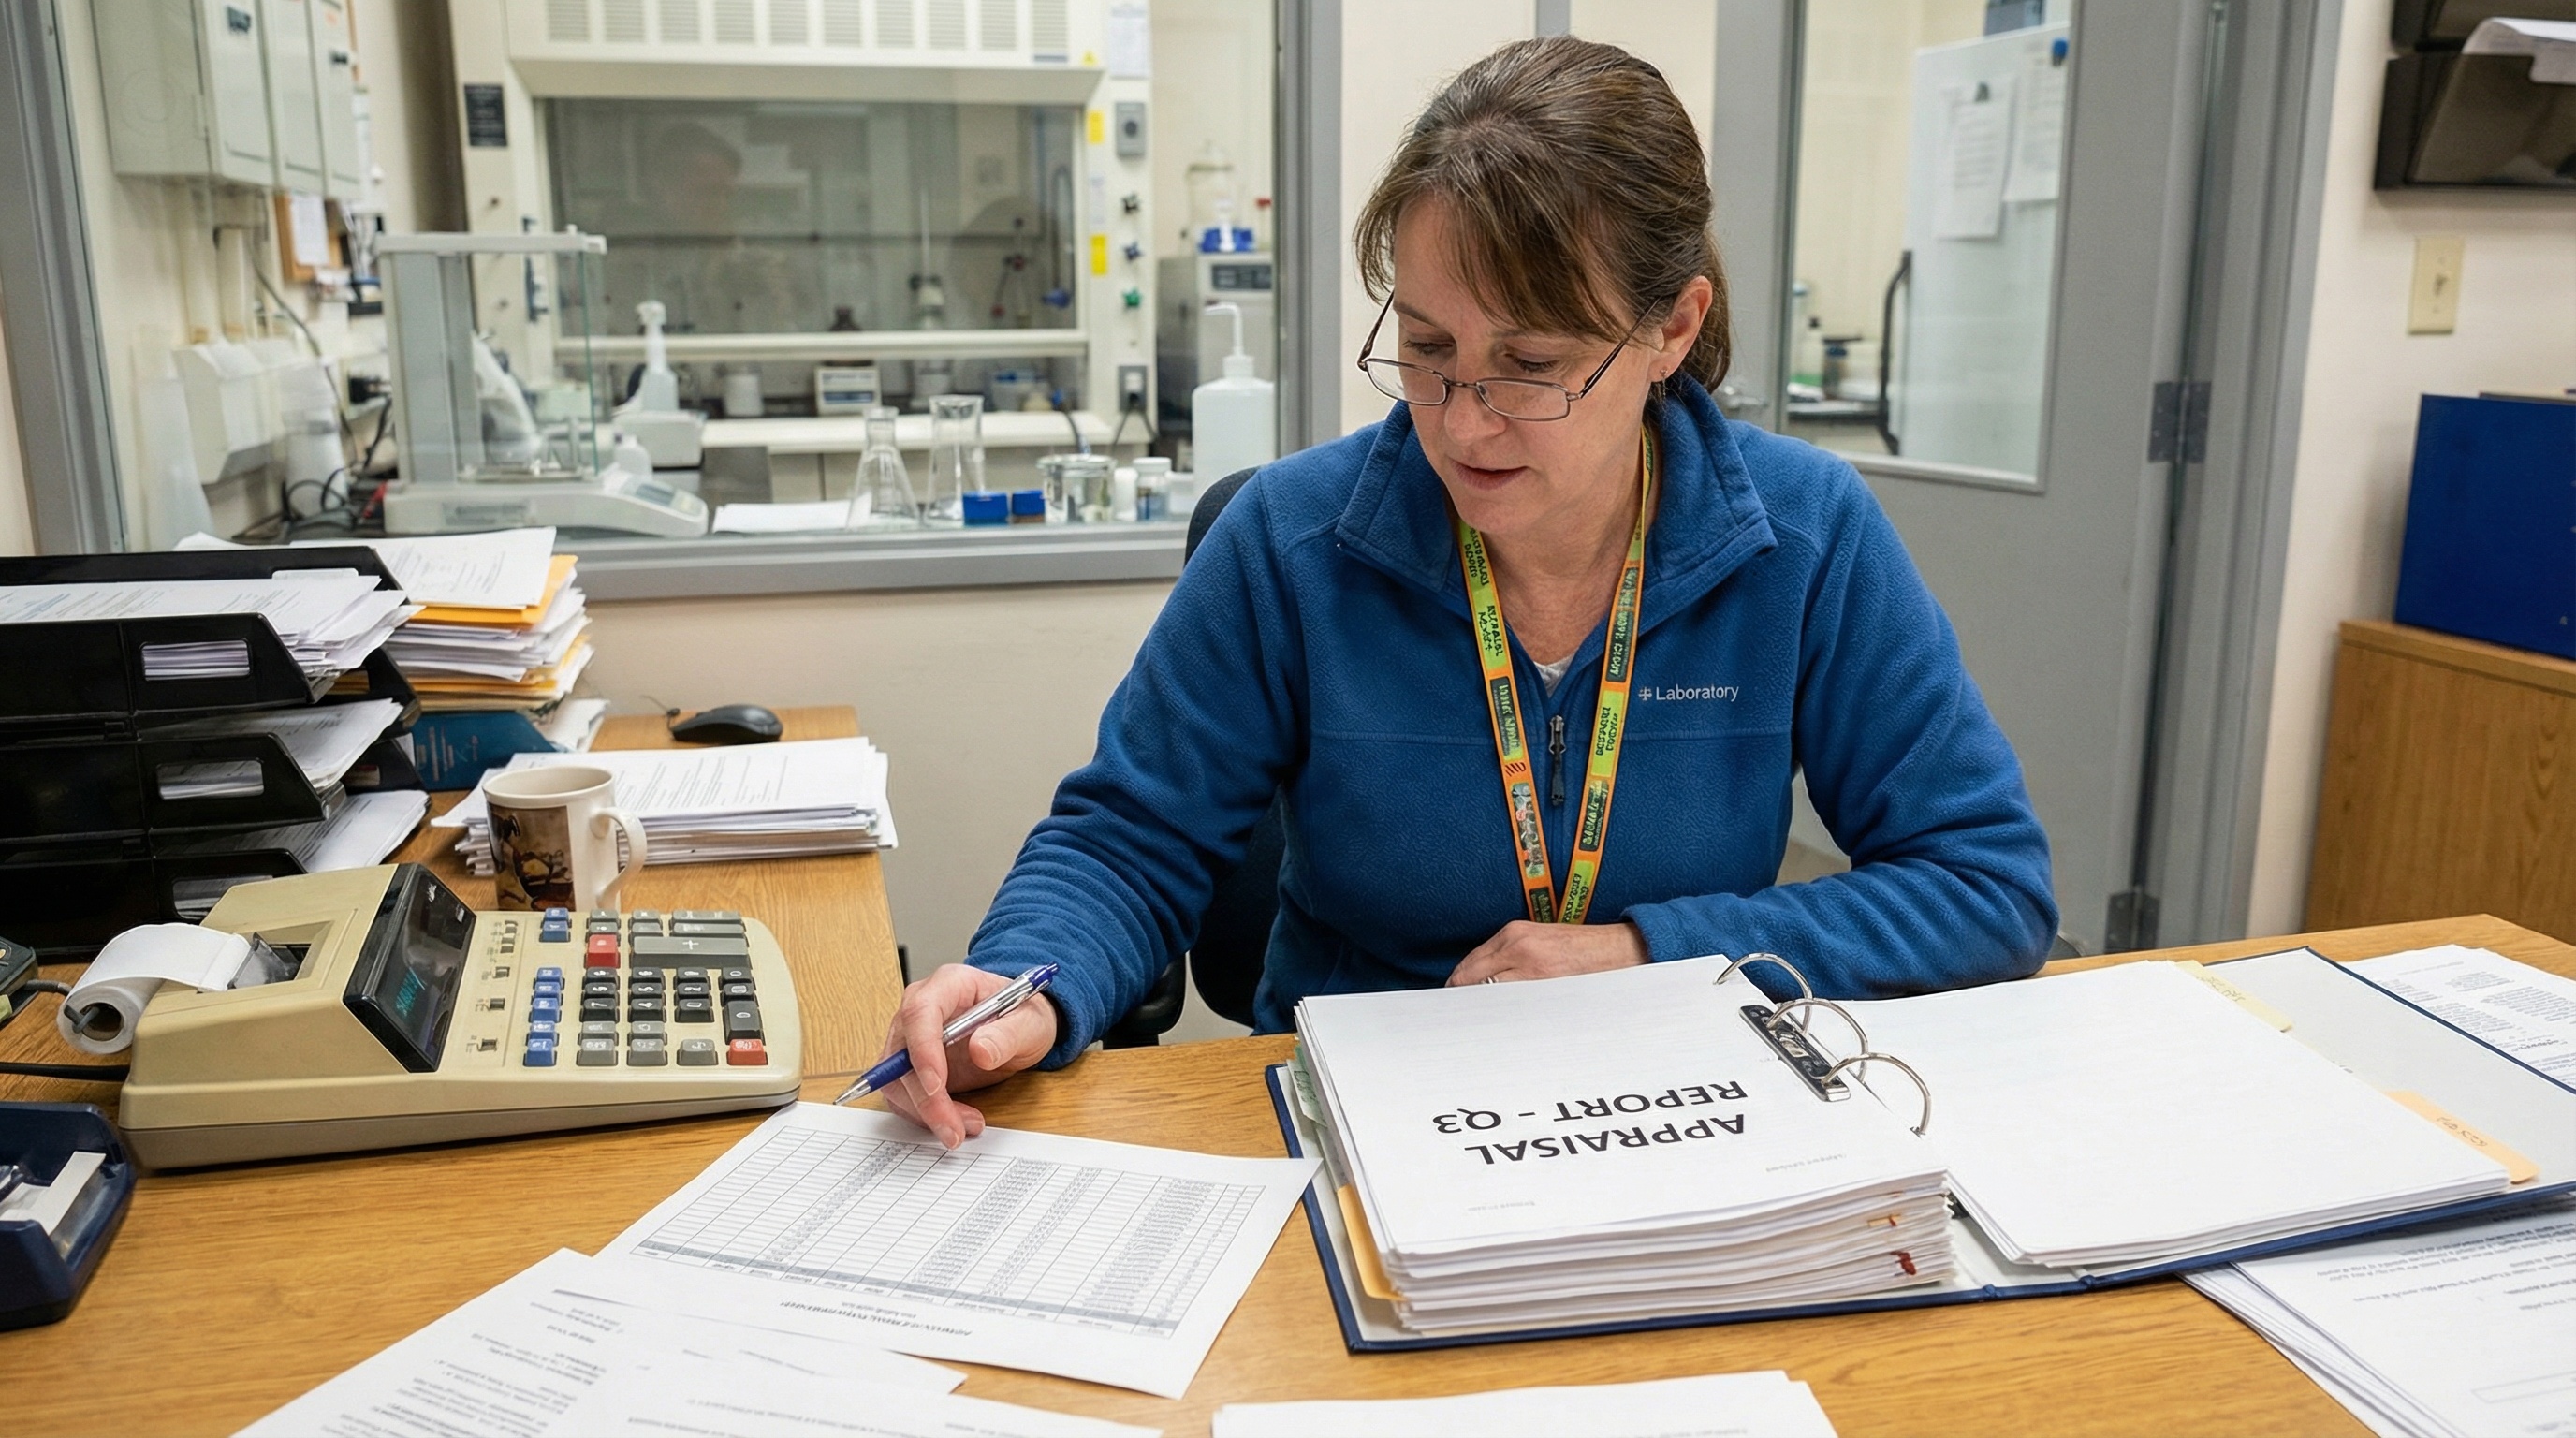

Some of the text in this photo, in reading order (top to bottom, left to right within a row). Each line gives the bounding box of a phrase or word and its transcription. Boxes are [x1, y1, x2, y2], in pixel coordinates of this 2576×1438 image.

[1656, 683, 1740, 702] Laboratory
[1553, 1080, 1749, 1123] REPORT
[1432, 1108, 1502, 1134] Q3
[1464, 1113, 1745, 1165] APPRAISAL
